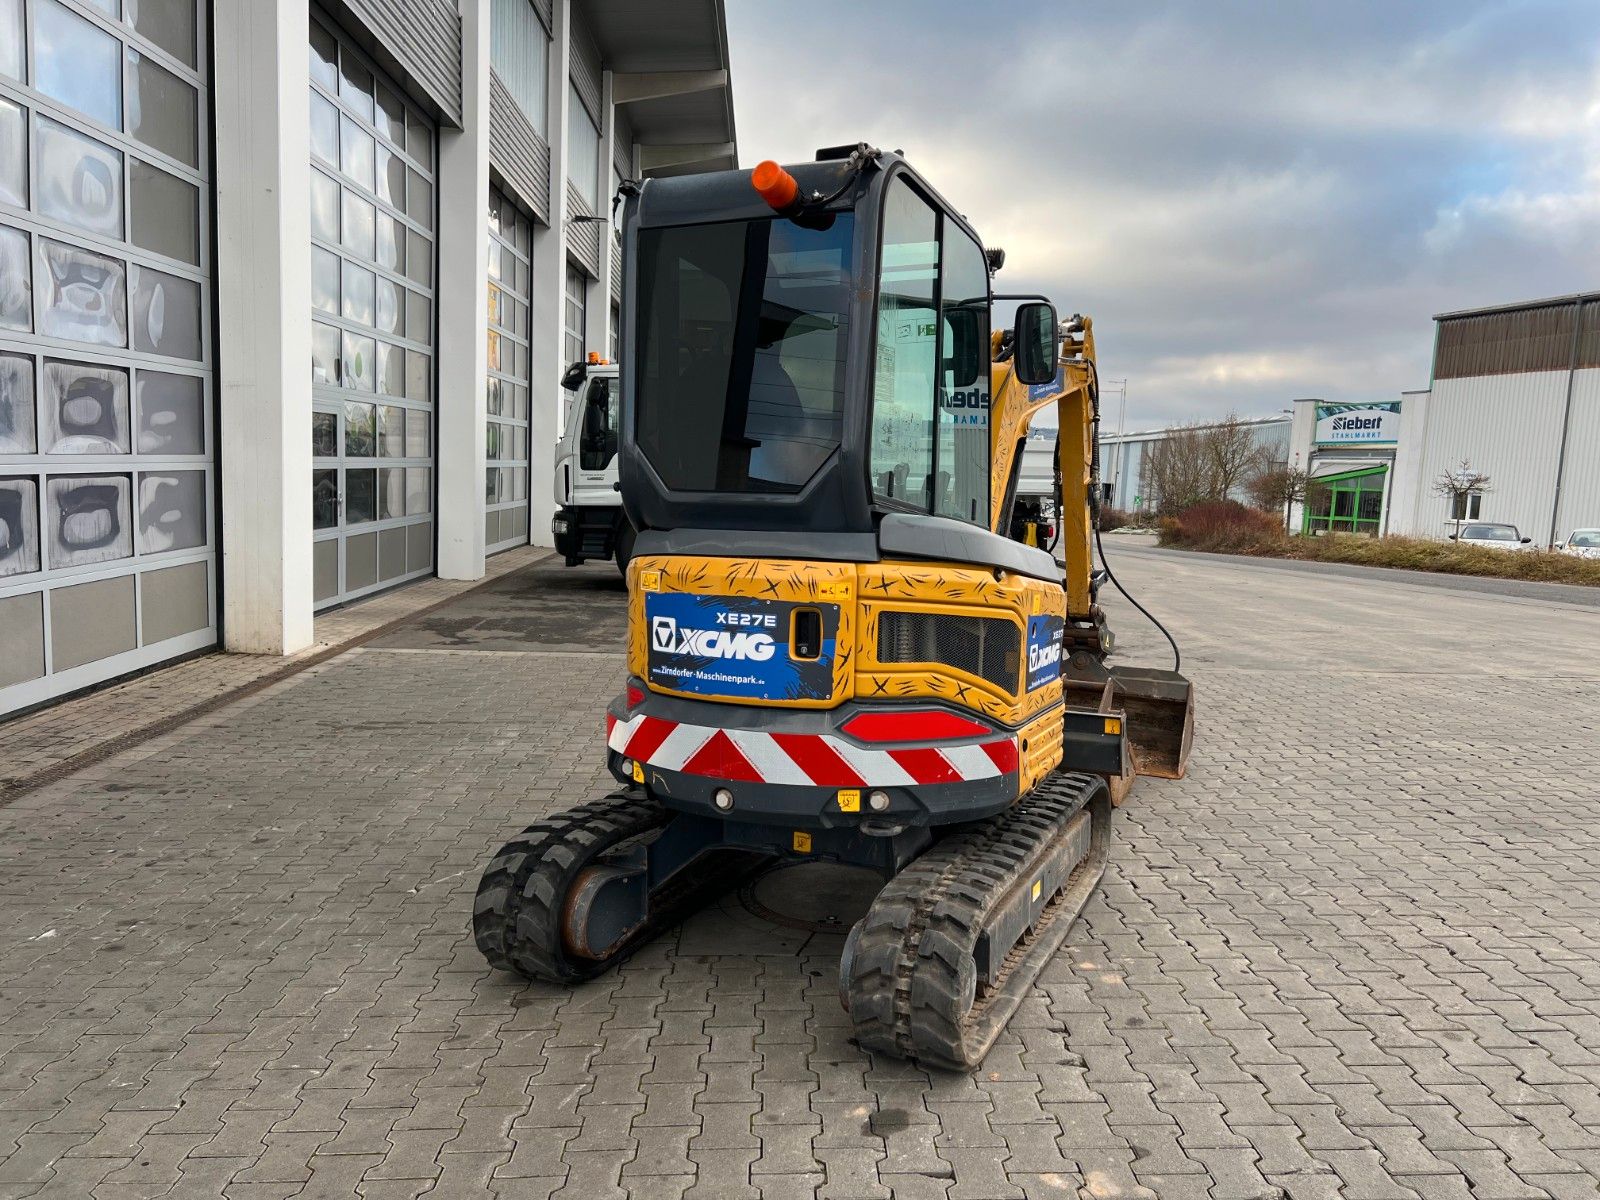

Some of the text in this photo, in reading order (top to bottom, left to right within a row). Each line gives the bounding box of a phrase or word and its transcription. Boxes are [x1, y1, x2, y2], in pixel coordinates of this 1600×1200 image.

[1332, 415, 1382, 430] Siebert
[1331, 431, 1381, 439] STAHLMARKT
[716, 612, 776, 627] XE27E
[676, 628, 776, 661] XCMG
[1037, 642, 1060, 668] XCMG
